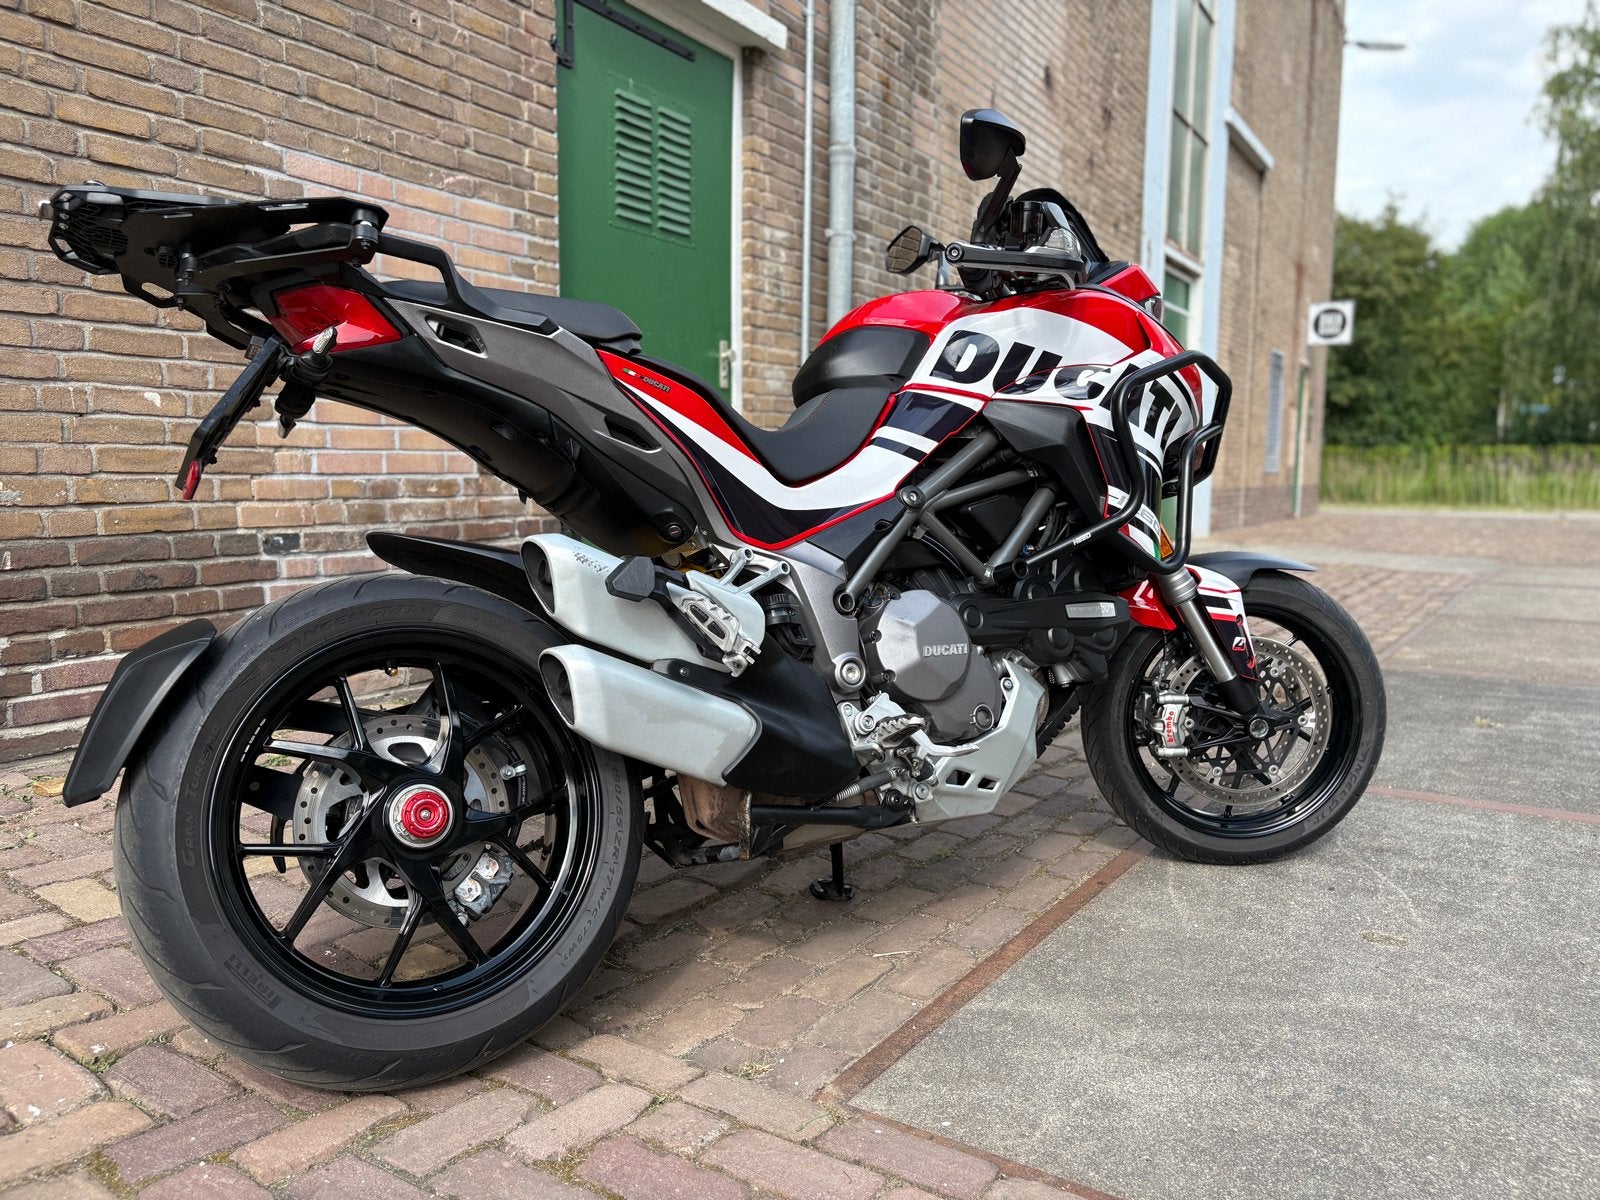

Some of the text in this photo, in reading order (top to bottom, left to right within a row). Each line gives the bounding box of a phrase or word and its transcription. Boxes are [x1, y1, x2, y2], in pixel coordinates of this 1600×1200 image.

[643, 376, 671, 393] DUCATI
[929, 330, 1182, 453] DUCATI
[923, 643, 968, 658] DUCATI
[1166, 711, 1174, 743] brembo
[182, 810, 197, 868] GRAN
[224, 953, 281, 1009] PIRELLI
